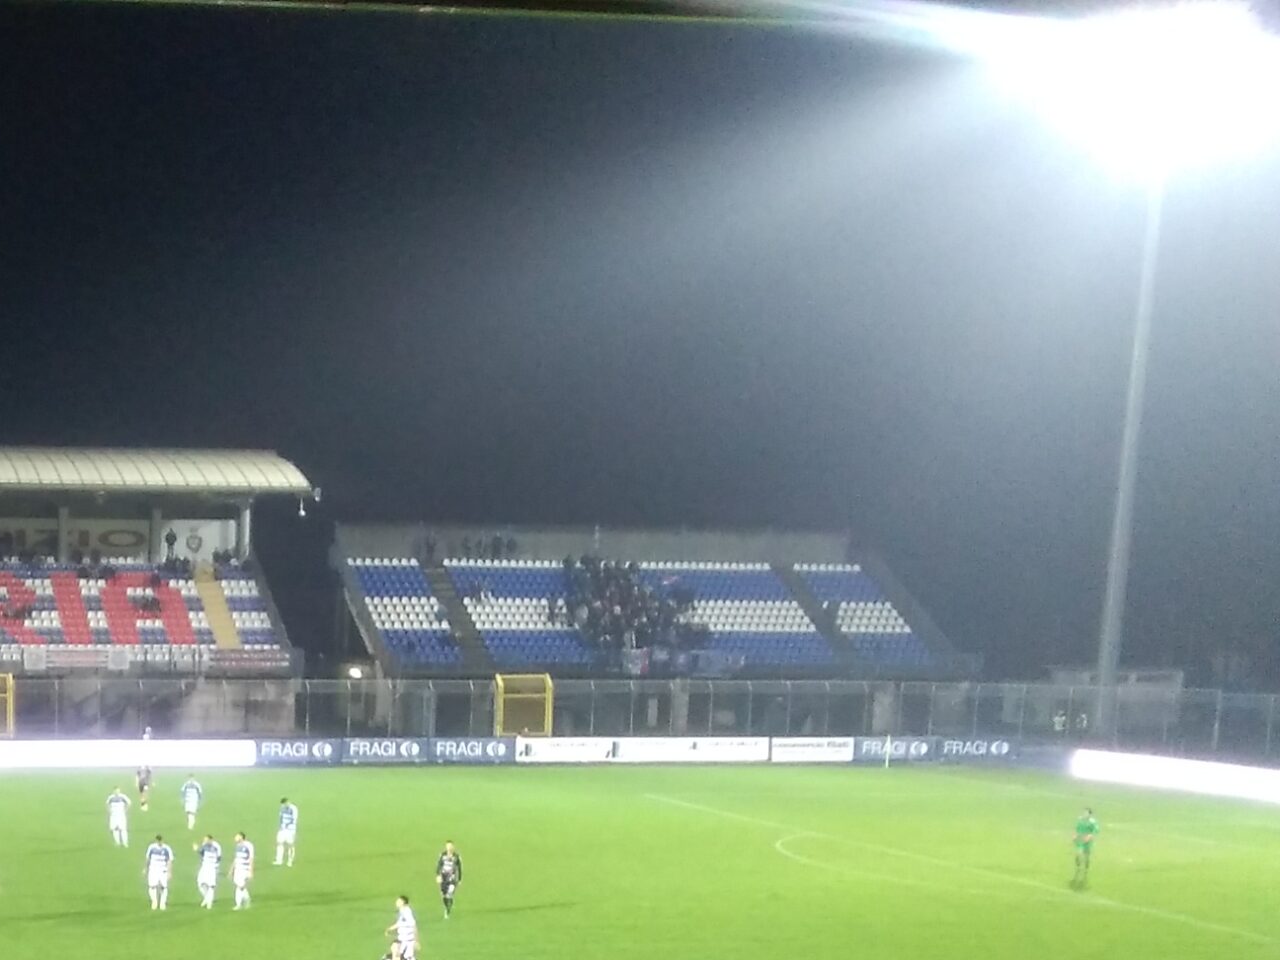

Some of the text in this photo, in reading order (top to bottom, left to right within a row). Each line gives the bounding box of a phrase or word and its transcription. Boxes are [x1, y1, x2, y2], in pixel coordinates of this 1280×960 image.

[261, 742, 308, 757] FRAGI
[349, 741, 396, 756] FRAGI
[436, 741, 482, 756] FRAGI
[862, 740, 906, 755] FRAGI
[943, 740, 988, 755] FRAGI
